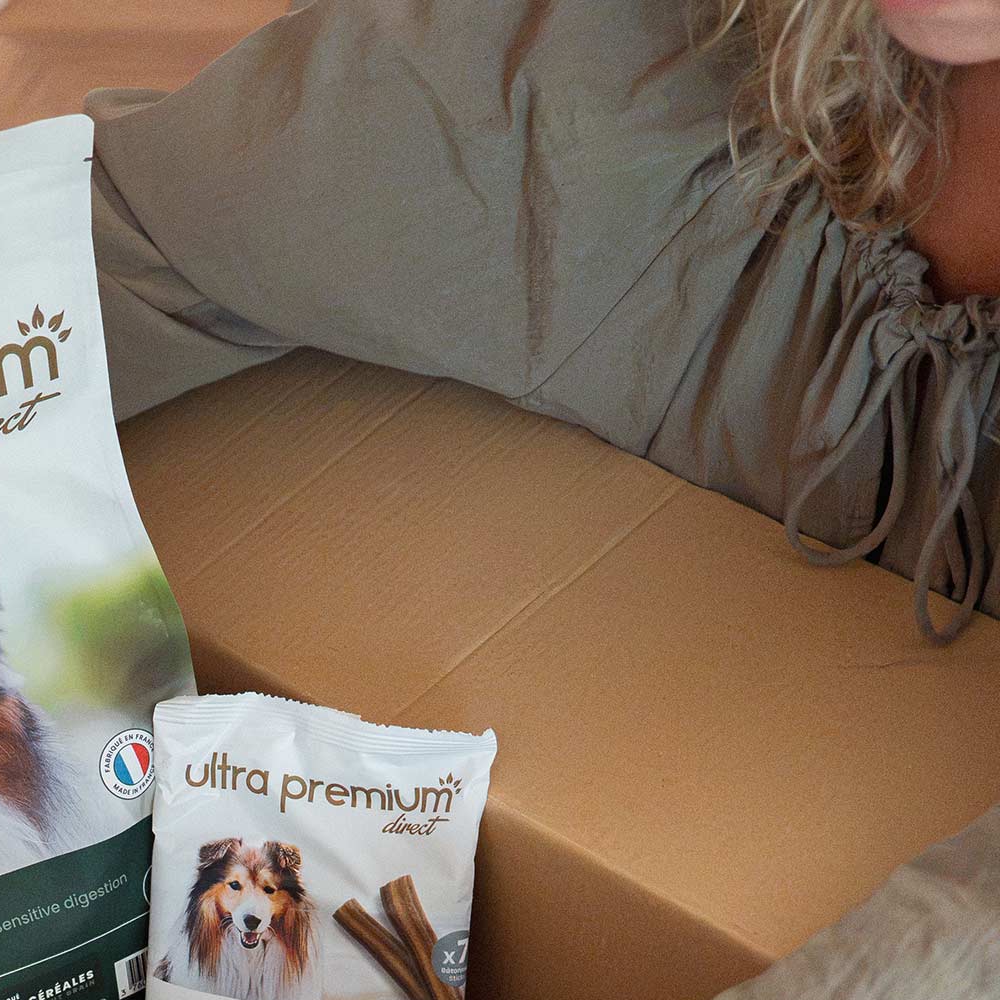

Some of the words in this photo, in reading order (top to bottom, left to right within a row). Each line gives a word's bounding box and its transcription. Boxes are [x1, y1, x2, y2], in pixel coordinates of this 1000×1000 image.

[124, 733, 134, 741] EN
[113, 783, 131, 796] MADE
[132, 787, 139, 795] IN
[185, 752, 270, 796] ultra
[280, 772, 454, 813] premium
[382, 813, 449, 836] direct
[63, 873, 128, 910] digestion
